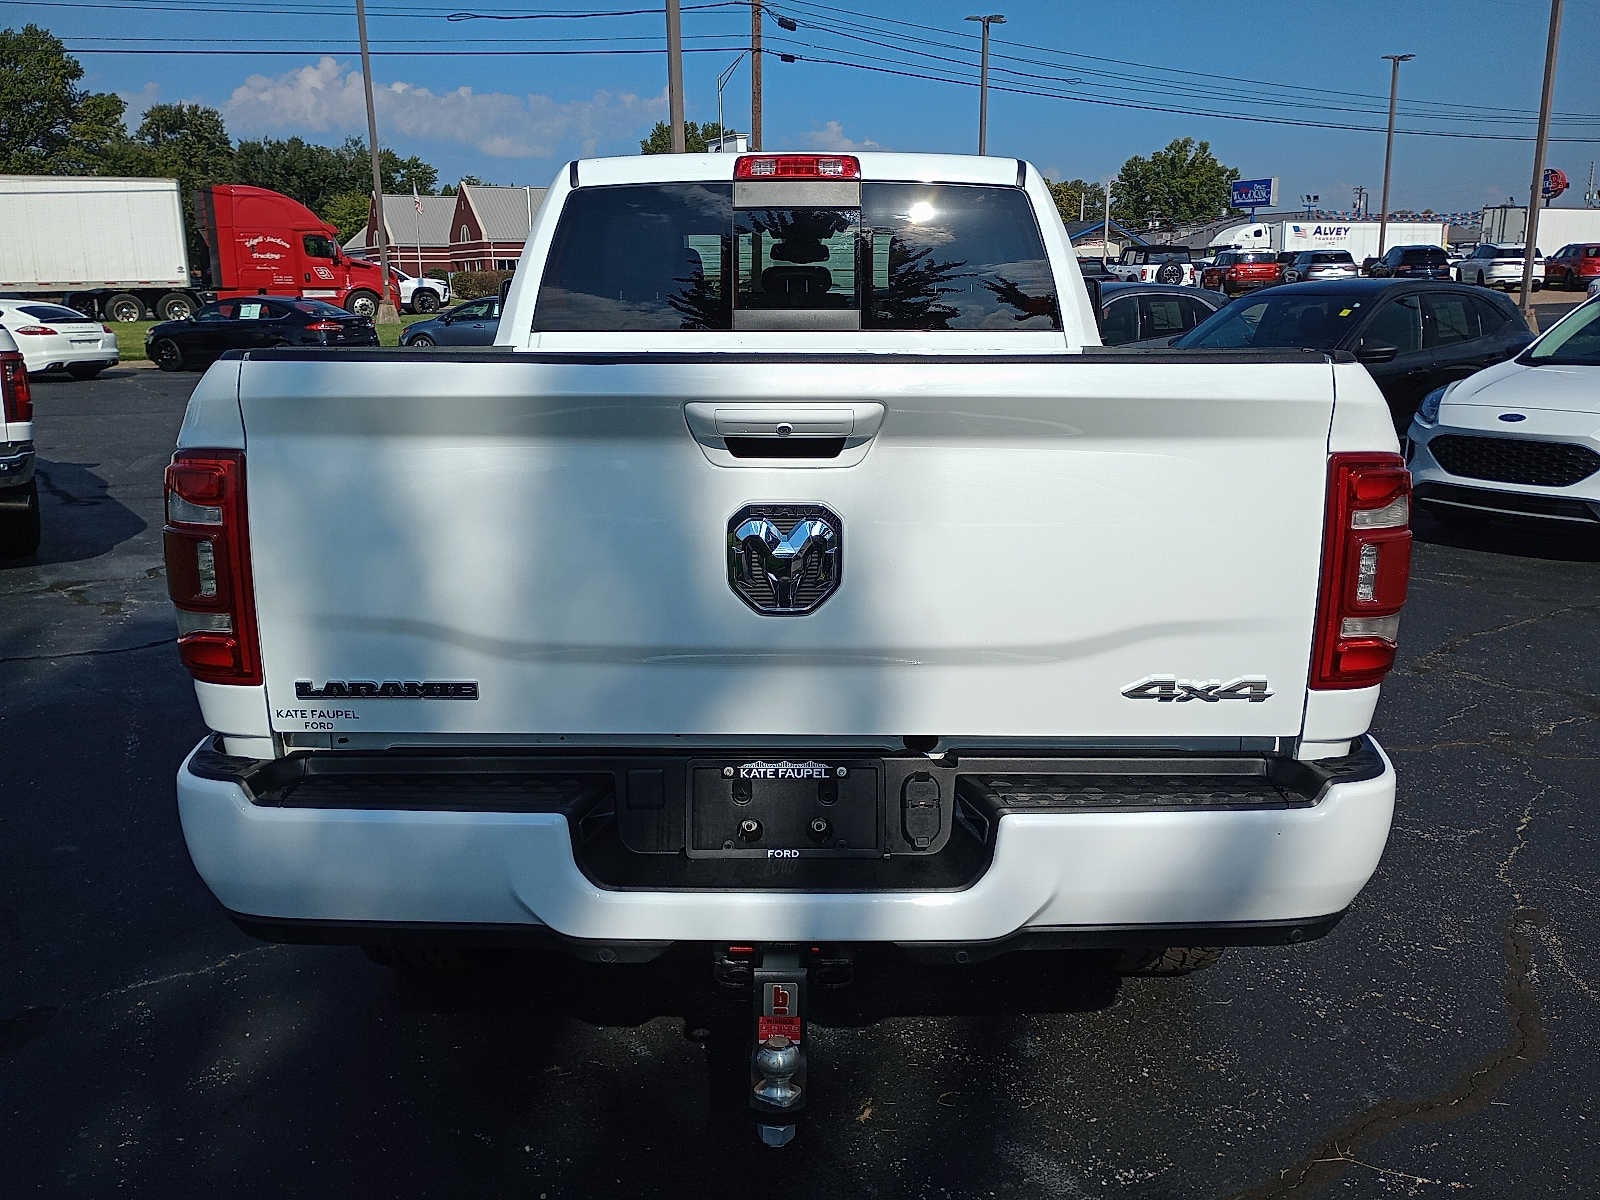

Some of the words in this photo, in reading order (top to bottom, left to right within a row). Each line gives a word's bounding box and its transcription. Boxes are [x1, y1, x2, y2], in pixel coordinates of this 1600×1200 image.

[1313, 225, 1351, 236] ALVEY
[276, 709, 308, 719] KATE
[310, 709, 360, 719] FAUPEL
[304, 722, 334, 730] FORD
[740, 768, 776, 779] KATE
[778, 768, 830, 779] FAUPEL
[767, 849, 800, 858] FORD
